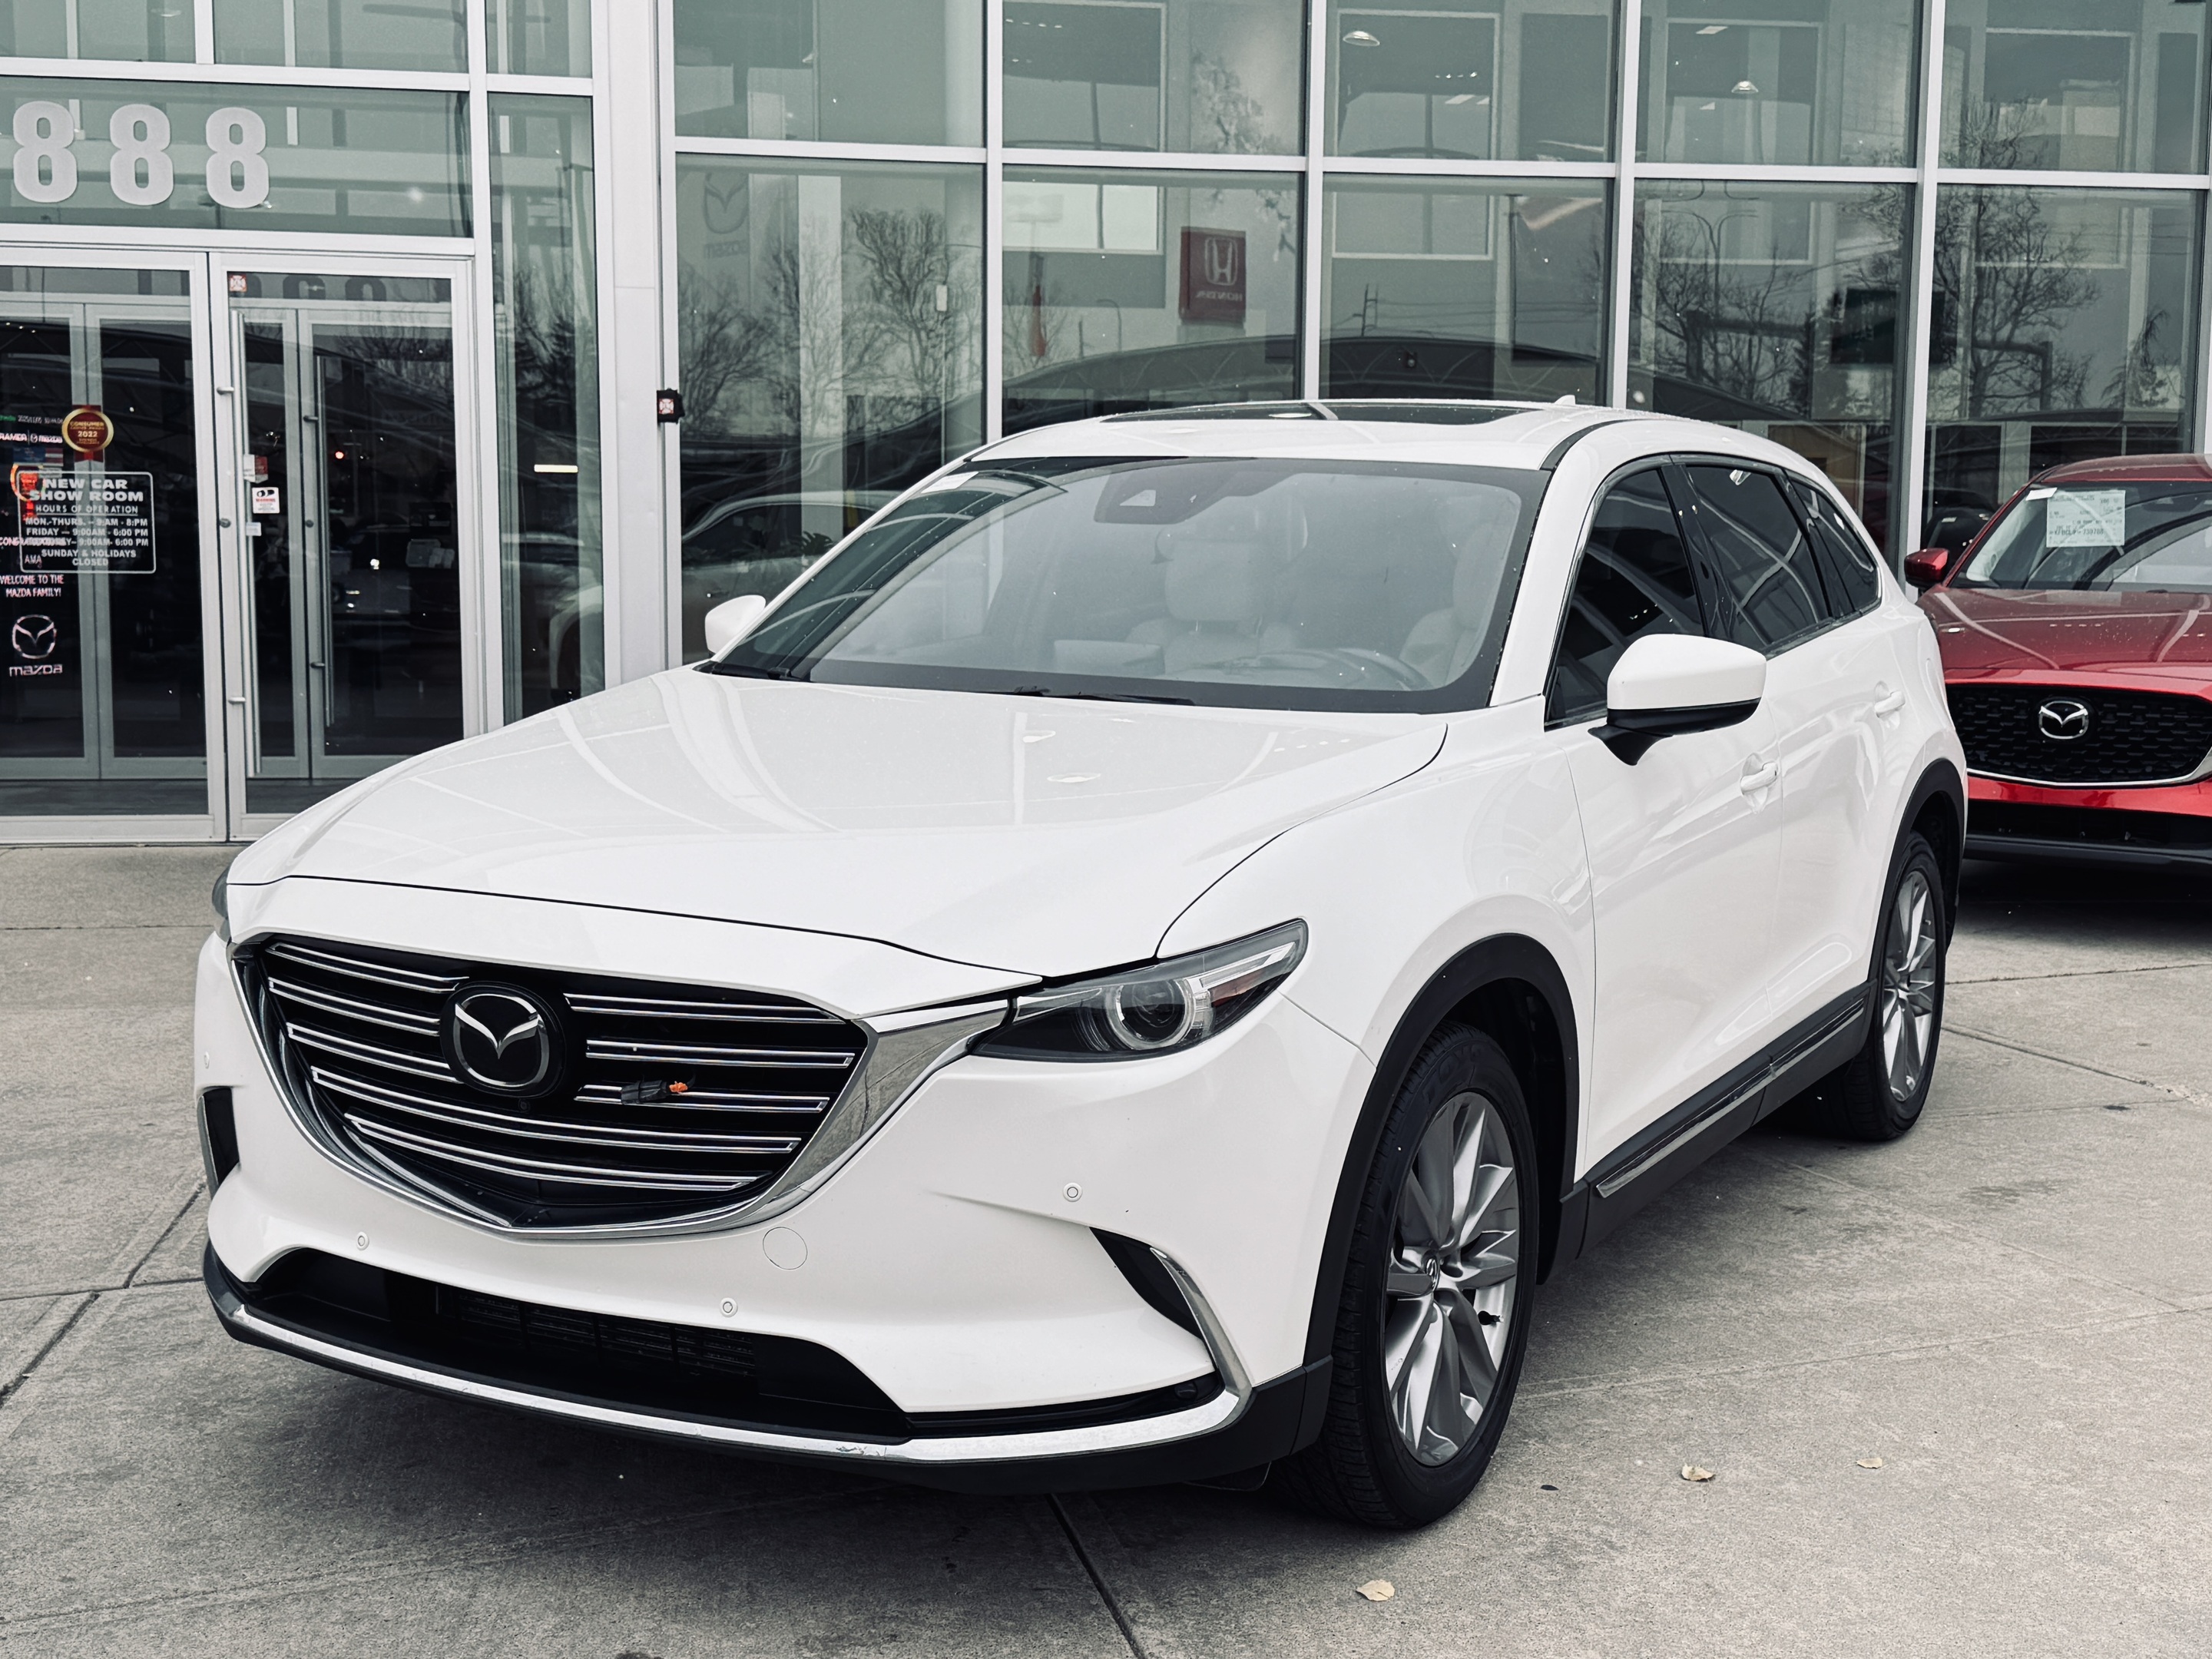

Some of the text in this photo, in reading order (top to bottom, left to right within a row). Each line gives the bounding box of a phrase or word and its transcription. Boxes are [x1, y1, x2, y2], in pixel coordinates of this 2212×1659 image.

[13, 101, 269, 208] 888
[45, 478, 85, 489] NEW
[91, 478, 128, 490] CAR
[29, 490, 144, 502] SHOW ROOM
[35, 505, 138, 514] HOURS OF OPERATION
[26, 528, 59, 536] FRIDAY
[134, 528, 148, 537] PM
[135, 538, 149, 547] PM
[41, 548, 78, 558] SUNDAY
[91, 549, 137, 558] HOLIDAYS
[72, 558, 109, 566] CLOSED
[0, 575, 65, 585] WELCOME TO THE
[6, 588, 62, 598] MAZDA FAMILY!
